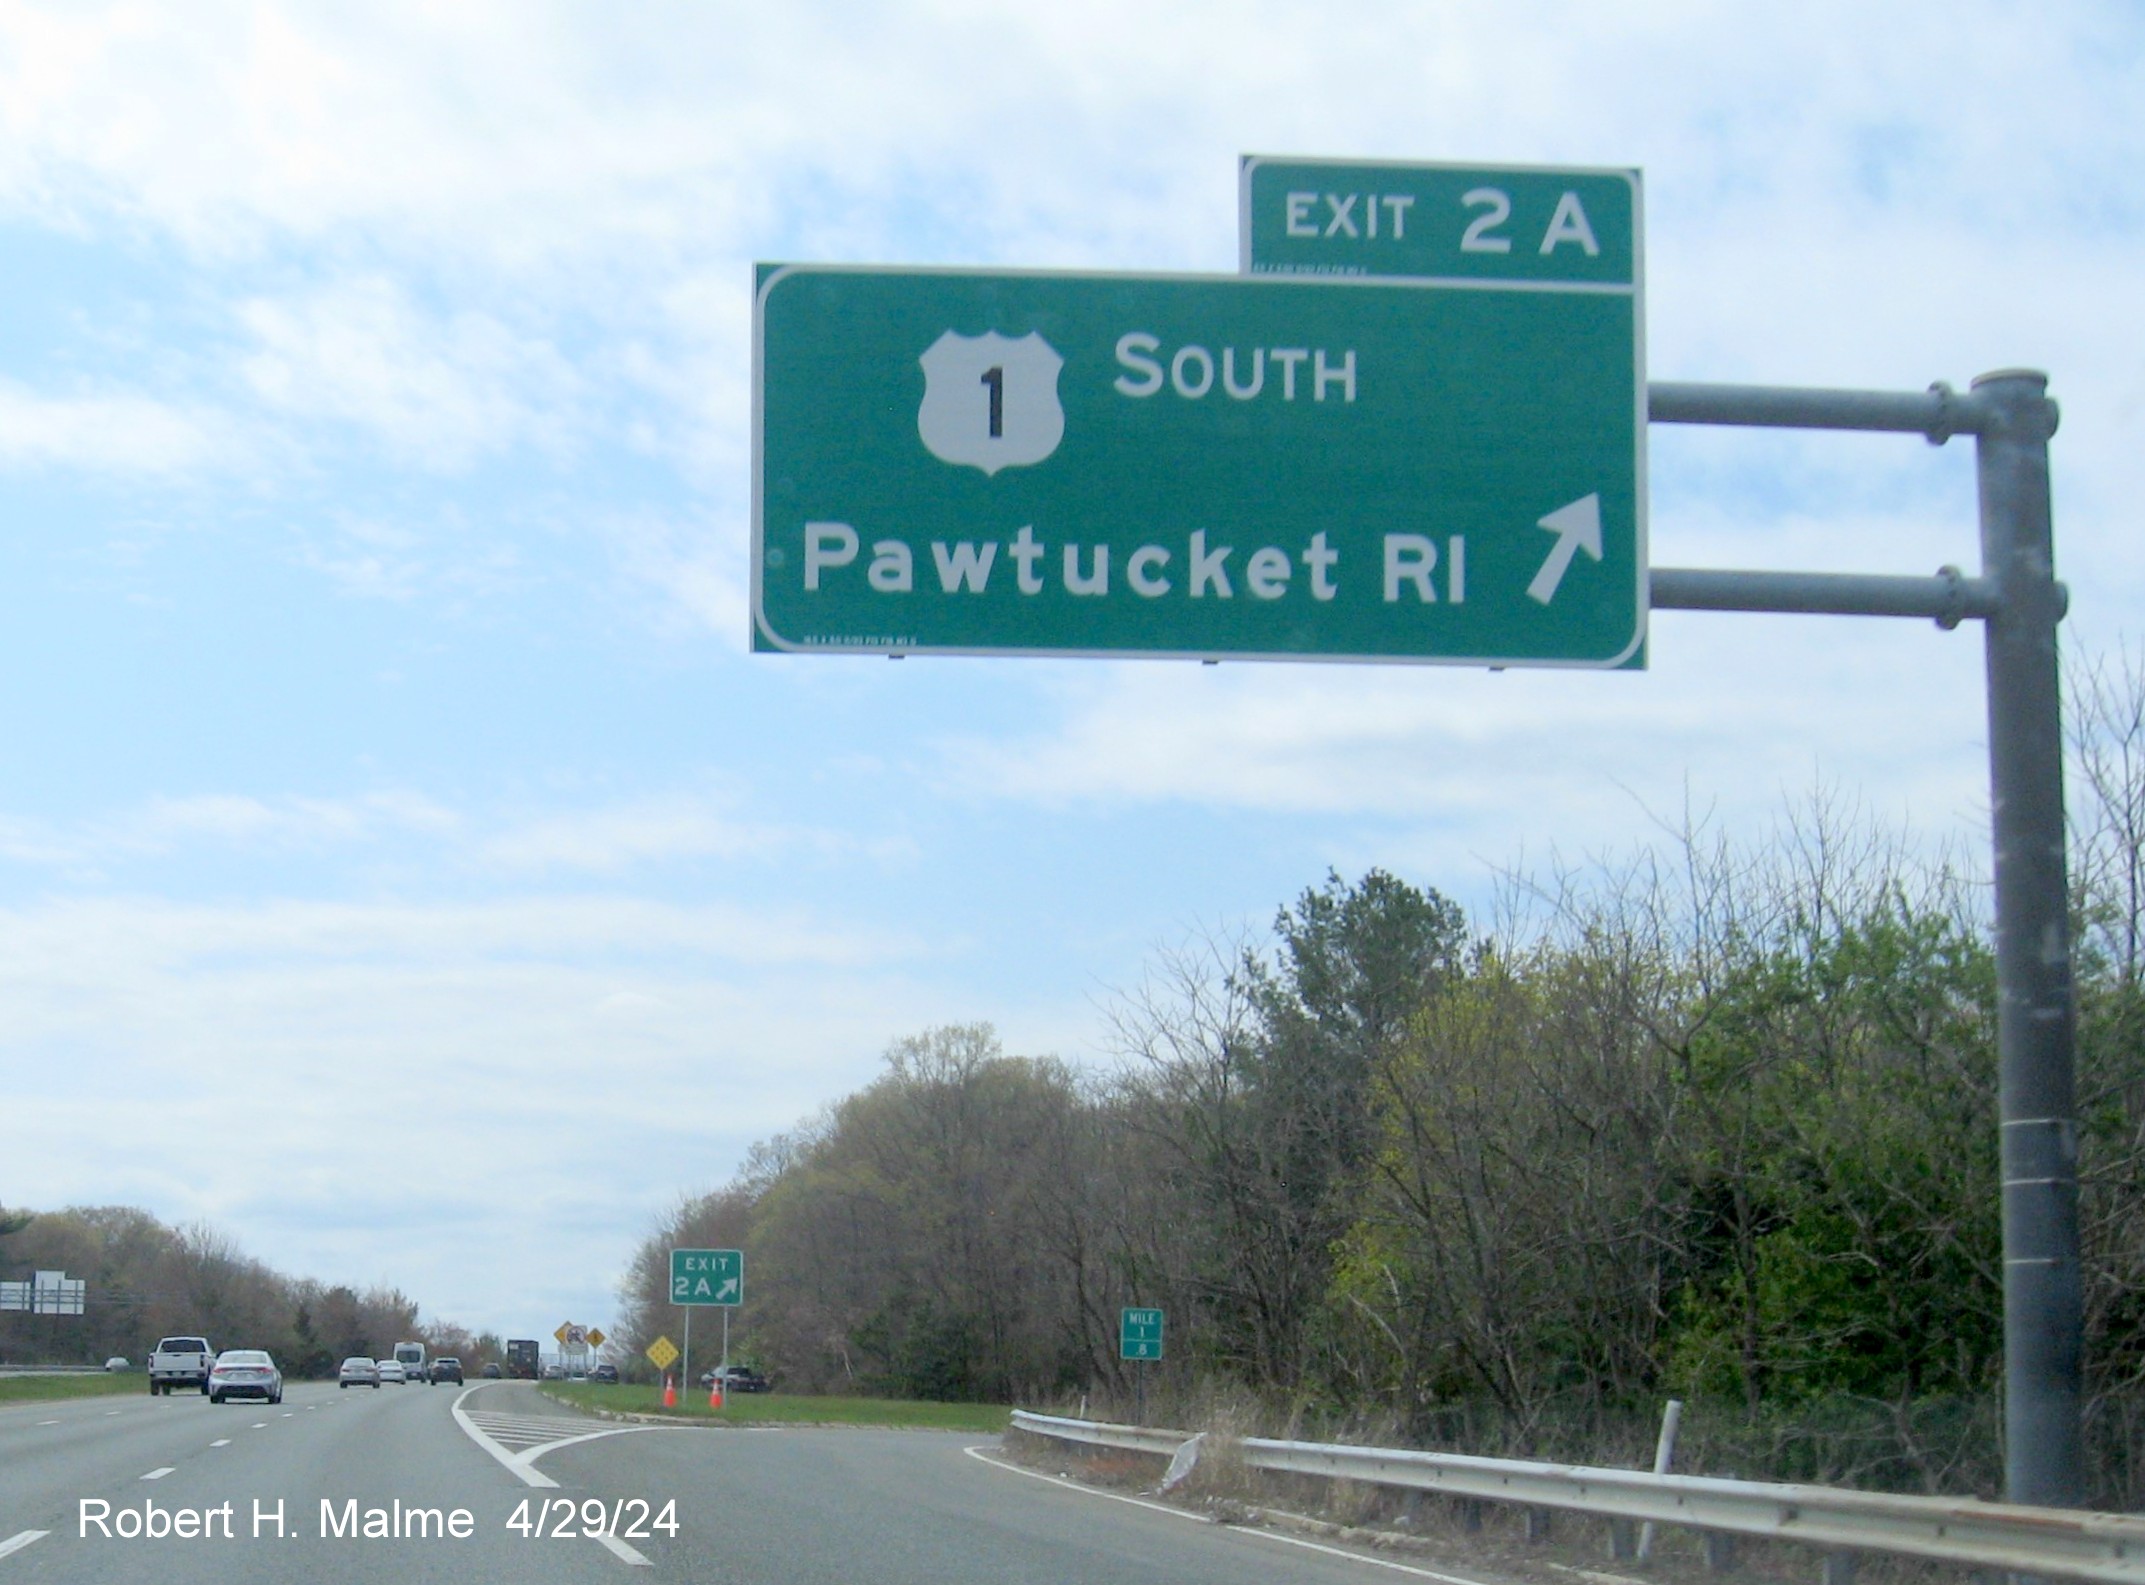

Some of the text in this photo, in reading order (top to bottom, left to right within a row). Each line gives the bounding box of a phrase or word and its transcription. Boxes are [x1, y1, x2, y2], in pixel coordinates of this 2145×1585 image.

[1286, 192, 1415, 239] EXIT
[1115, 332, 1357, 403] SOUTH
[980, 365, 1004, 440] 1
[803, 522, 1465, 604] Pawtucket RI
[685, 1257, 729, 1271] EXIT
[1129, 1312, 1155, 1325] MILE
